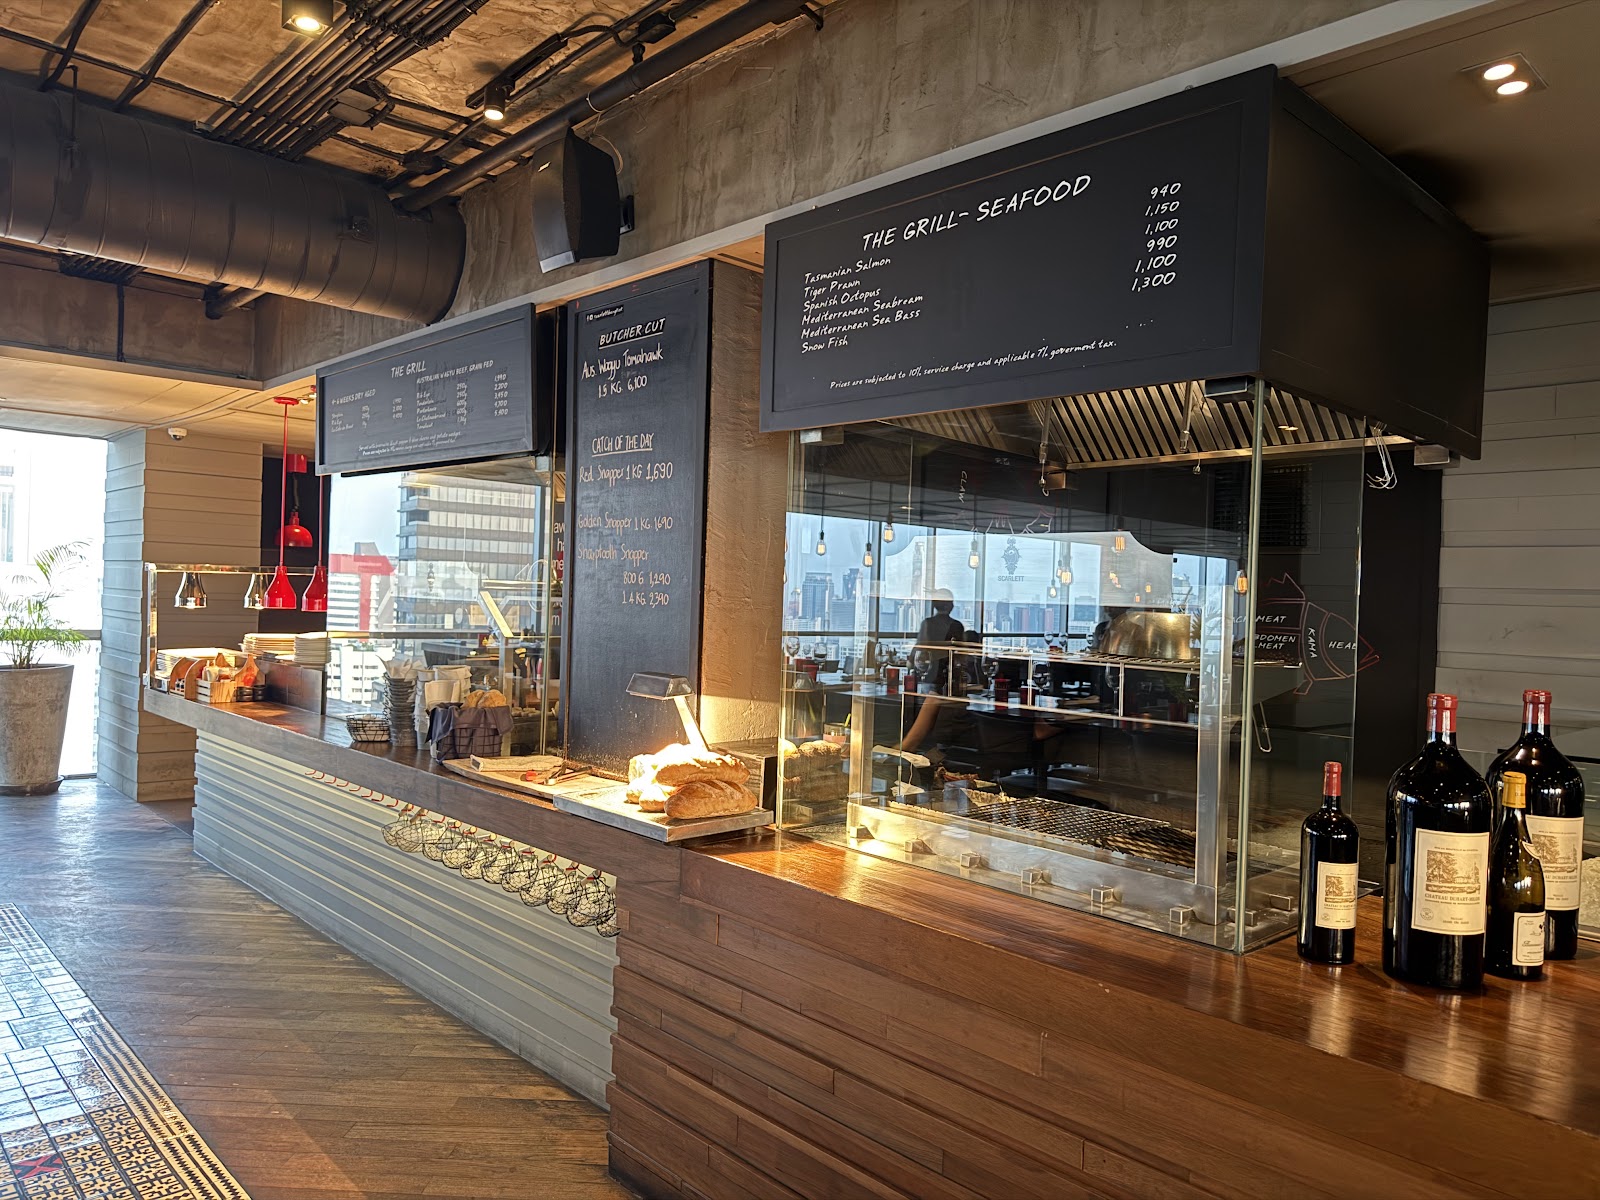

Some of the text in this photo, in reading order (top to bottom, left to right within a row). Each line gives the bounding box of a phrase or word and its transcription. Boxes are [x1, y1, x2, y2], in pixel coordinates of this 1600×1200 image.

[1150, 183, 1182, 199] 940
[862, 227, 897, 250] THE
[976, 174, 1092, 221] SEAFOOD
[1145, 201, 1180, 216] 1,150
[1145, 219, 1178, 235] 1,100
[1147, 235, 1177, 252] 990
[804, 257, 891, 284] Tasmanian Salmon
[1135, 254, 1177, 273] 1,100
[804, 280, 860, 301] Tiger Prawn
[1132, 272, 1176, 292] 1,300
[802, 295, 923, 326] Mediterranean Seabream
[803, 288, 881, 314] Spanish Octopus
[600, 318, 666, 345] BUTCHER CUT
[801, 309, 920, 339] Mediterranean Sea Bass
[622, 342, 664, 367] Tomahawk
[801, 335, 848, 353] Snow Fish
[391, 360, 426, 378] THE GRILL
[416, 373, 439, 384] AUSTRALIAN
[440, 369, 456, 379] WAGYU
[469, 362, 483, 372] GRAIN
[483, 359, 494, 368] FED
[830, 381, 850, 389] Prices
[865, 373, 896, 385] subjected
[898, 371, 906, 379] to
[908, 366, 922, 377] 10%
[924, 365, 949, 375] service
[951, 361, 975, 372] charge
[977, 357, 992, 367] and
[994, 350, 1035, 366] applicable
[1037, 345, 1049, 358] 7%
[1049, 340, 1096, 360] goverment
[1098, 339, 1117, 348] tax.
[627, 375, 648, 392] 6,100
[340, 394, 354, 403] WEEKS
[354, 391, 364, 400] DRY
[364, 388, 376, 397] AGED
[592, 432, 654, 453] CATCH OF THE DAY
[579, 462, 673, 487] Red Snapper 1 KG 1,690
[958, 470, 968, 503] CLAW
[578, 513, 602, 528] Golden
[604, 511, 632, 536] Snapper
[634, 516, 638, 530] 1
[620, 543, 649, 567] Snapper
[623, 570, 636, 584] 800
[649, 571, 671, 588] 1,290
[649, 591, 670, 608] 2,390
[1255, 615, 1287, 623] MEAT
[1258, 642, 1285, 650] MEAT
[1308, 627, 1318, 658] KAMA
